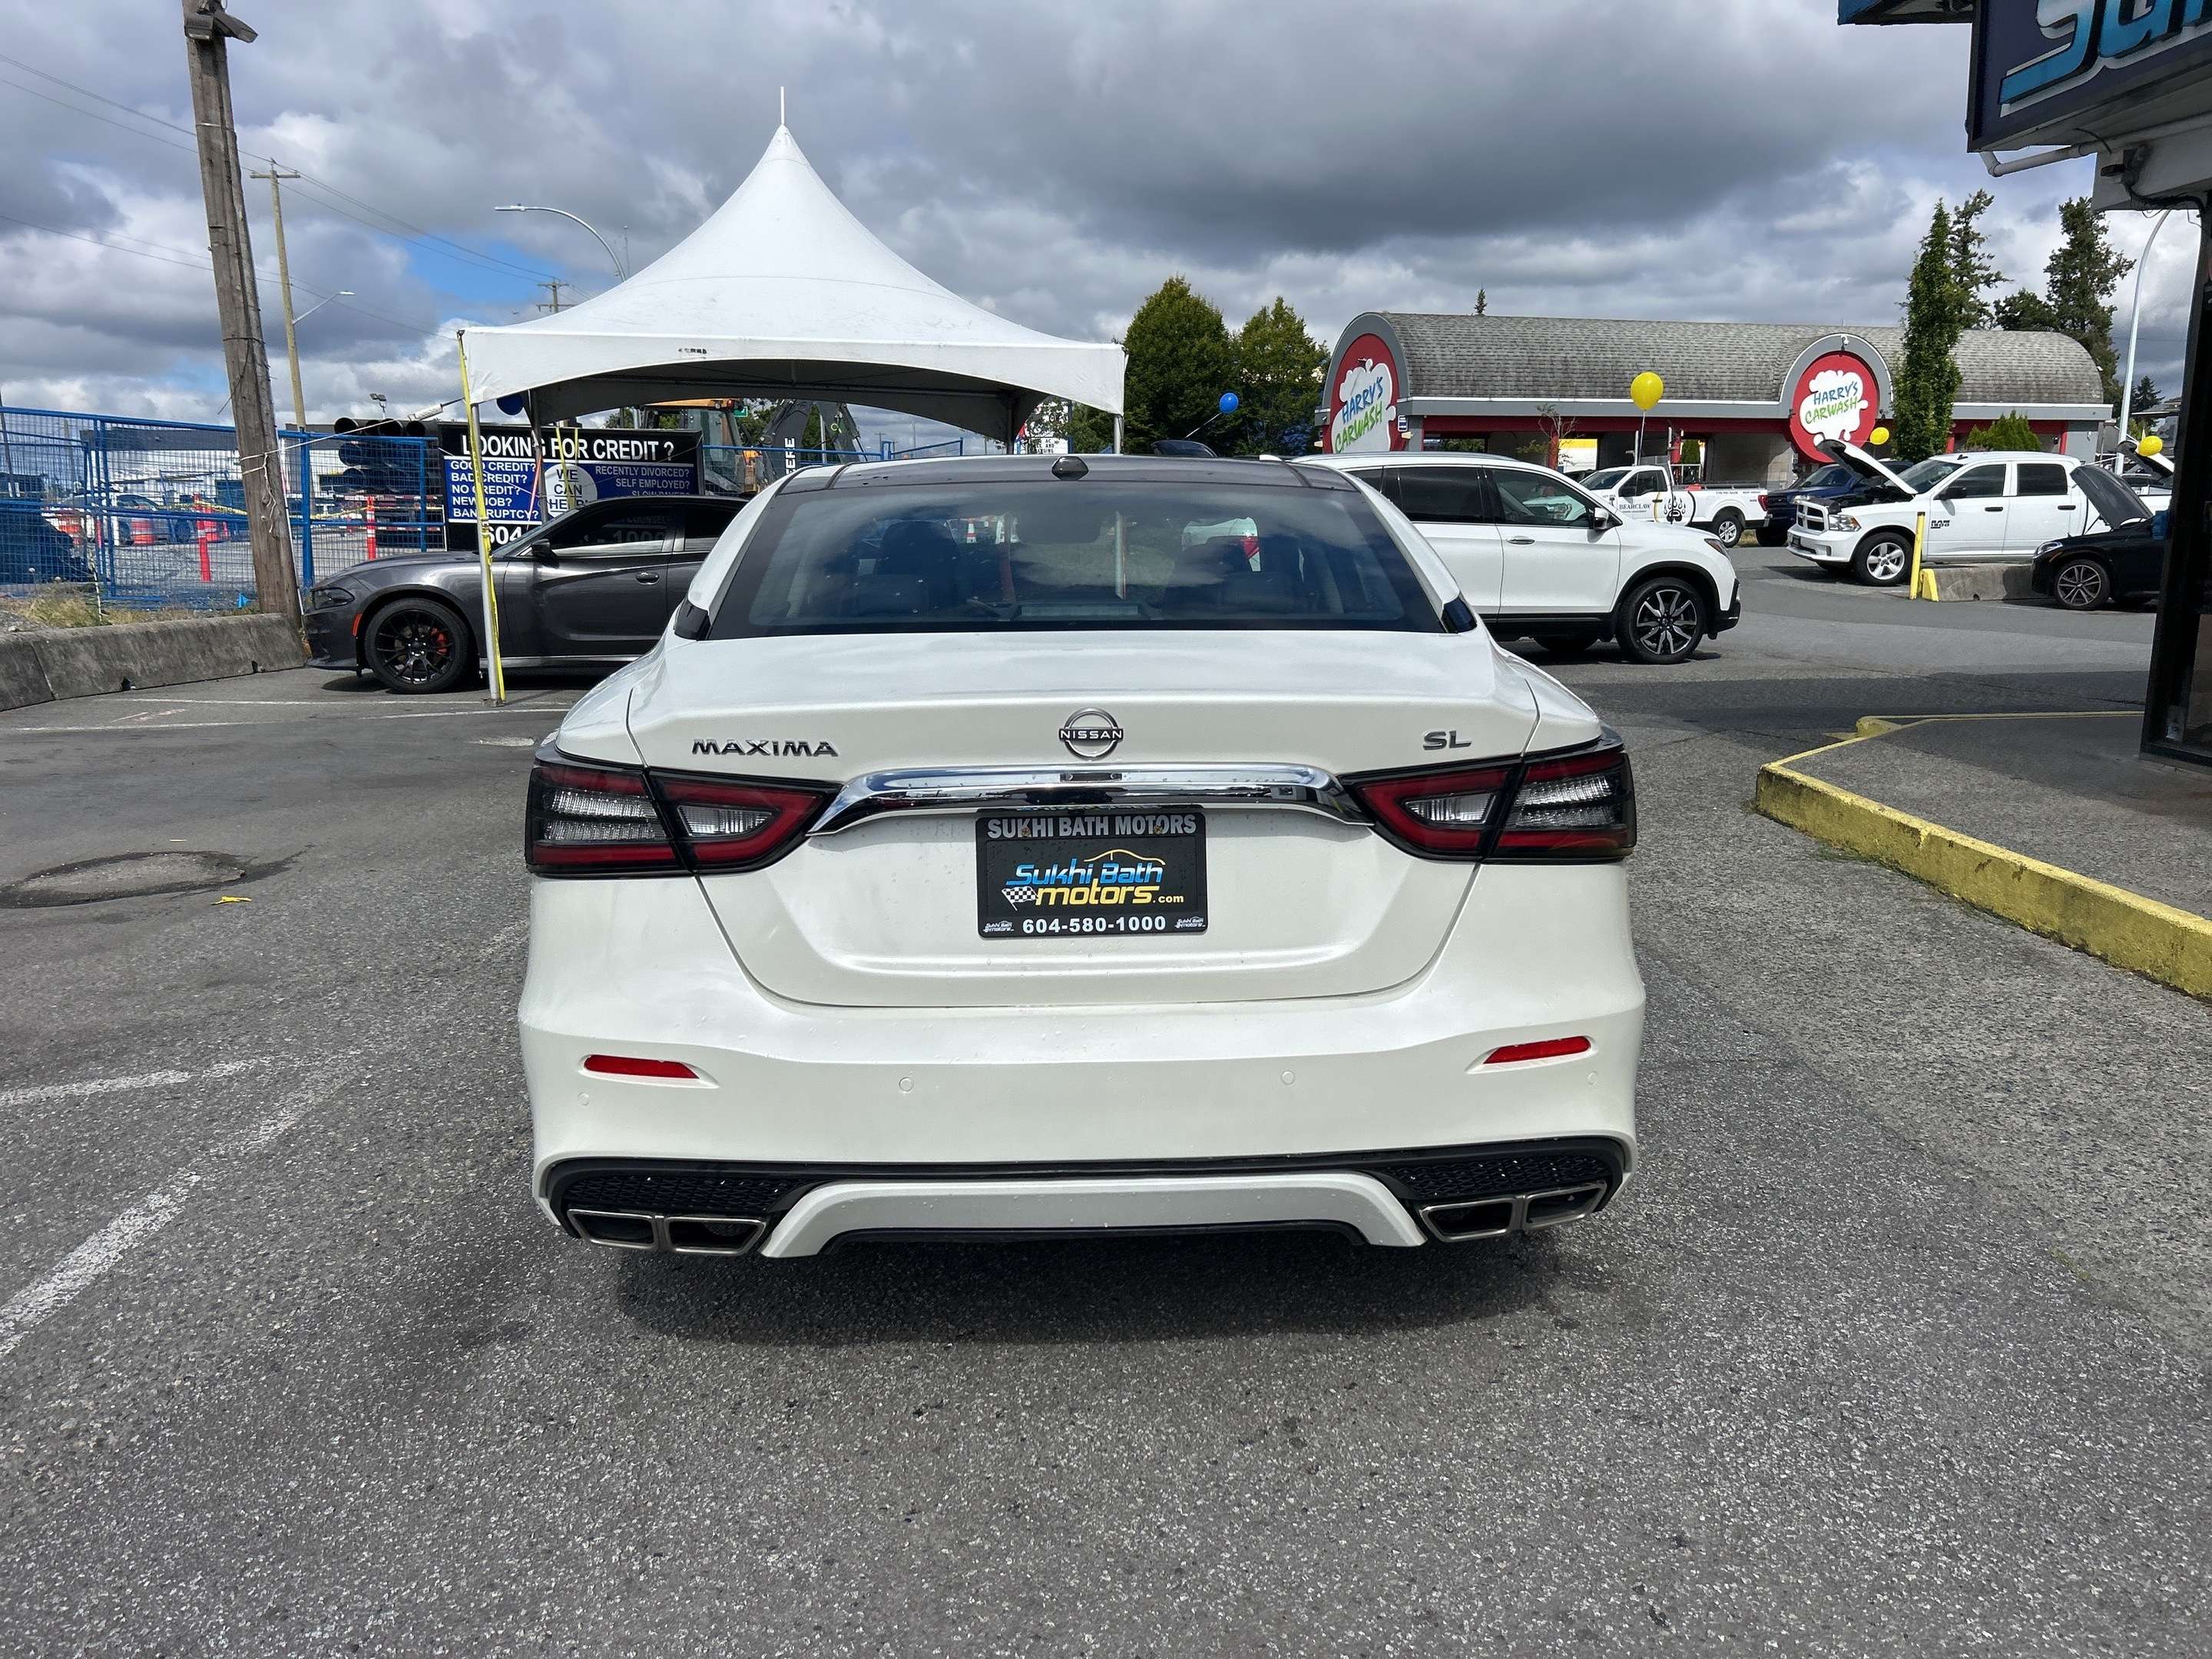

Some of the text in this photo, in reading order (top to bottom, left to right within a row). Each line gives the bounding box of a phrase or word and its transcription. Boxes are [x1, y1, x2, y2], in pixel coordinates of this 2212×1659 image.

[1813, 381, 1858, 405] HARRY'S
[1805, 396, 1858, 424] CARWASH
[1335, 400, 1382, 453] CARWASH
[551, 437, 590, 459] FOR
[594, 439, 659, 461] CREDIT
[488, 462, 536, 472] CREDIT?
[595, 465, 690, 478] RECENTLY DIVORCED?
[452, 473, 474, 482] BAD
[556, 469, 578, 480] WE
[452, 485, 469, 494] NO
[555, 484, 582, 495] CAN
[615, 478, 690, 489] SELF EMPLOYED?
[452, 497, 476, 506] NEW
[453, 508, 539, 519] BANRUPTCY?
[1060, 730, 1122, 739] NISSAN
[1422, 730, 1472, 751] SL
[691, 738, 839, 757] MAXIMA
[987, 814, 1197, 839] SUKHI BATH MOTORS
[1005, 858, 1164, 886] Sukhi Bath
[1022, 916, 1166, 934] 604-580-1000
